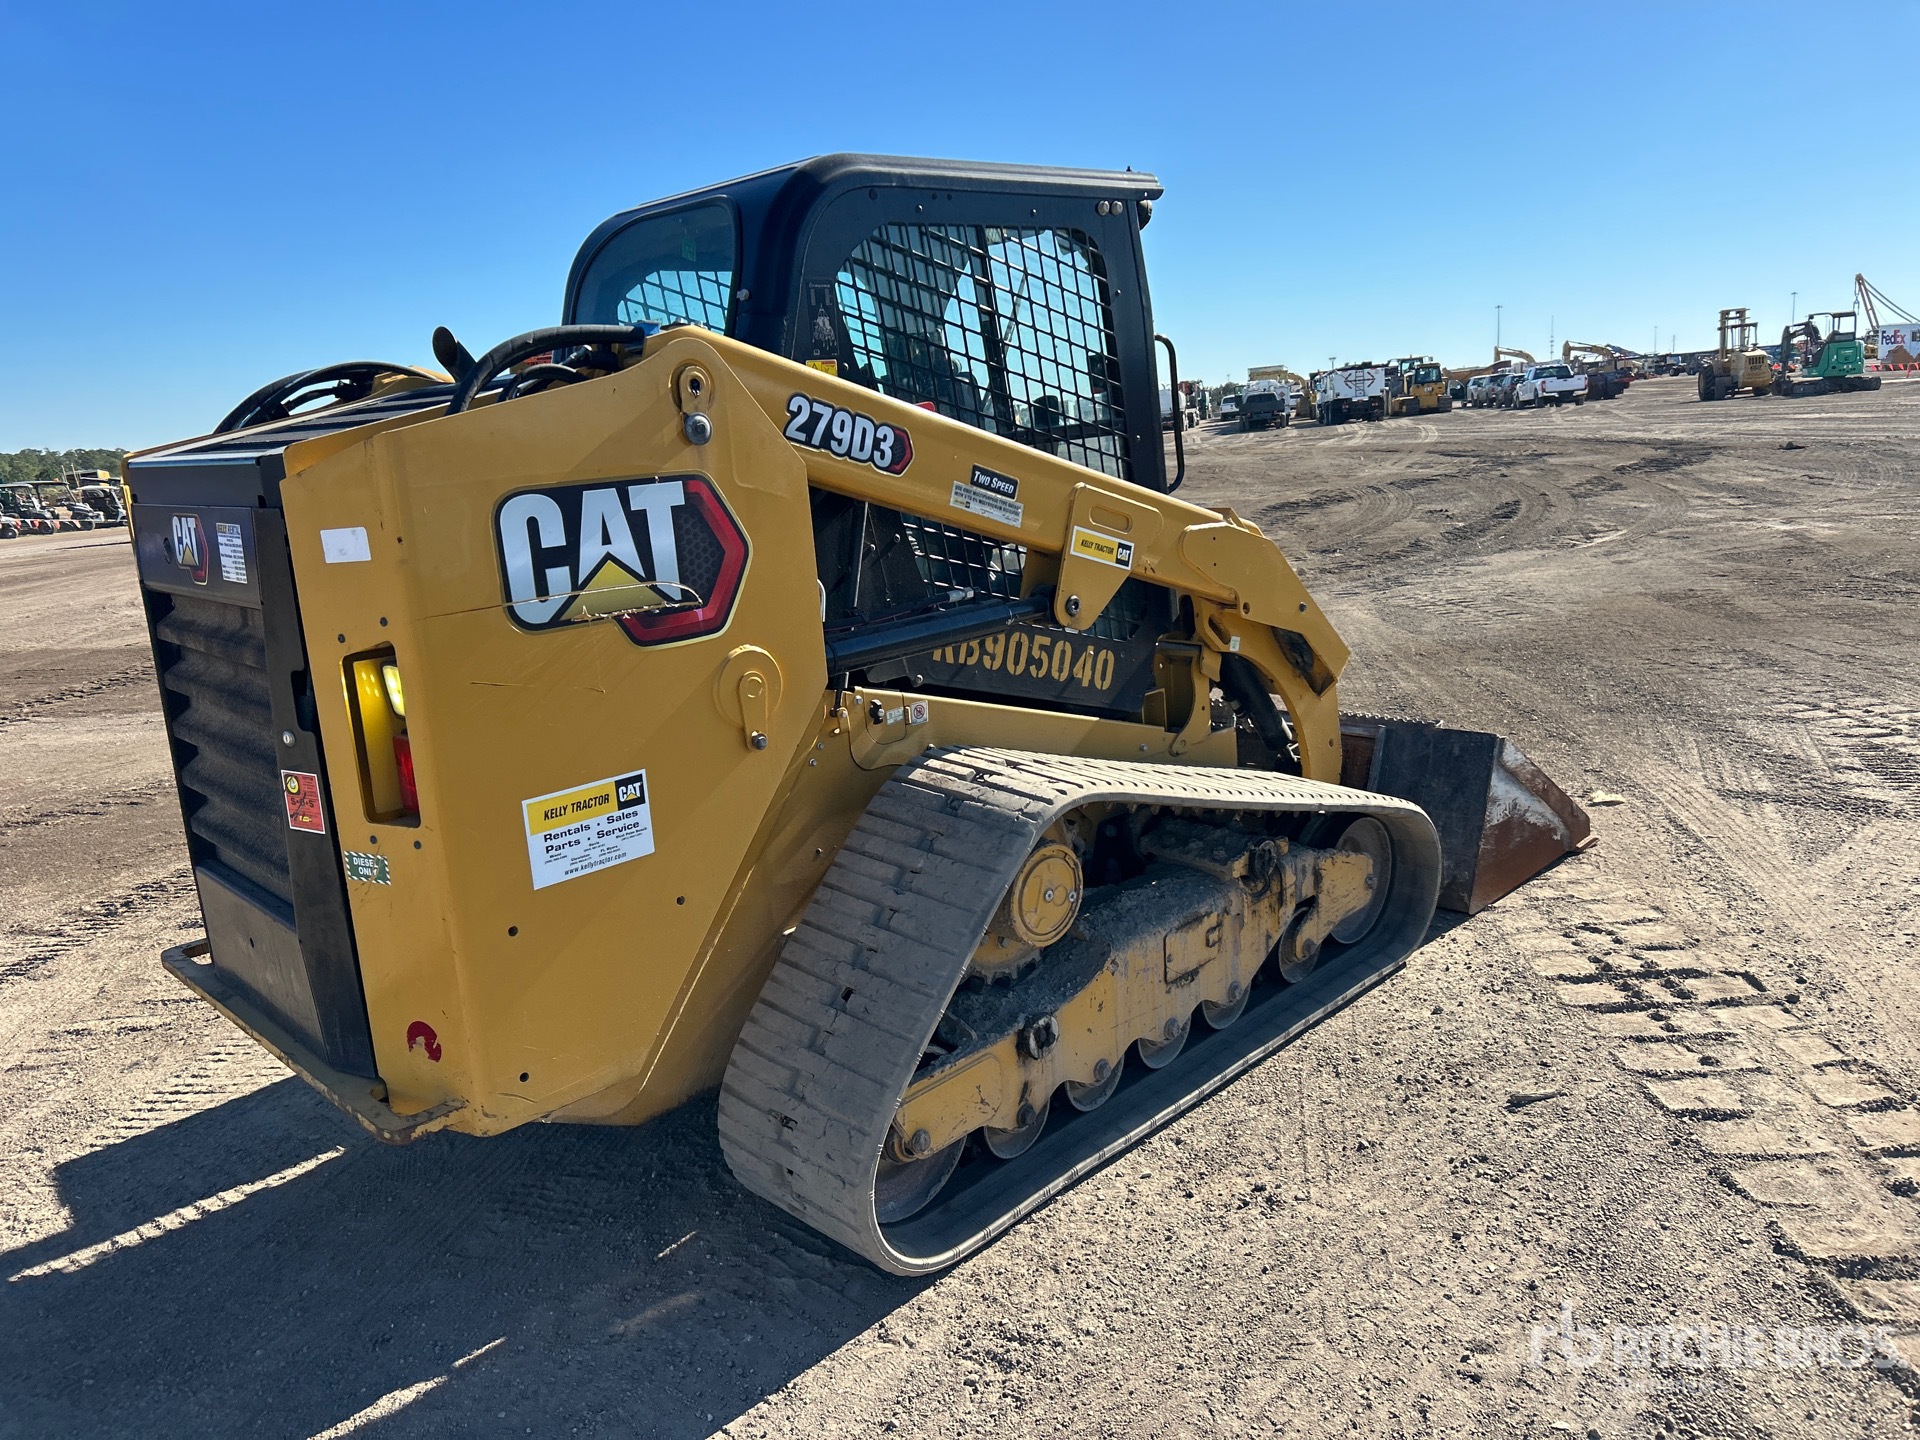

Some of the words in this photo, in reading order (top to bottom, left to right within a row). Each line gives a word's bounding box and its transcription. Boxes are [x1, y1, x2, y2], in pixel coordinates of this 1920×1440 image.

[1881, 329, 1906, 345] FedEx
[784, 395, 895, 469] 279D3
[991, 477, 1014, 494] SPEED
[172, 515, 200, 567] CAT
[500, 481, 685, 624] CAT
[1094, 543, 1114, 555] TRACTOR
[1117, 547, 1130, 561] CAT
[543, 804, 569, 821] KELLY
[571, 793, 610, 813] TRACTOR
[618, 781, 643, 802] CAT
[543, 823, 591, 843] Rentals
[606, 809, 639, 825] Sales
[545, 837, 581, 854] Parts
[597, 820, 640, 839] Service
[353, 857, 379, 868] DIESEL
[564, 852, 627, 876] www.kellytractor.com
